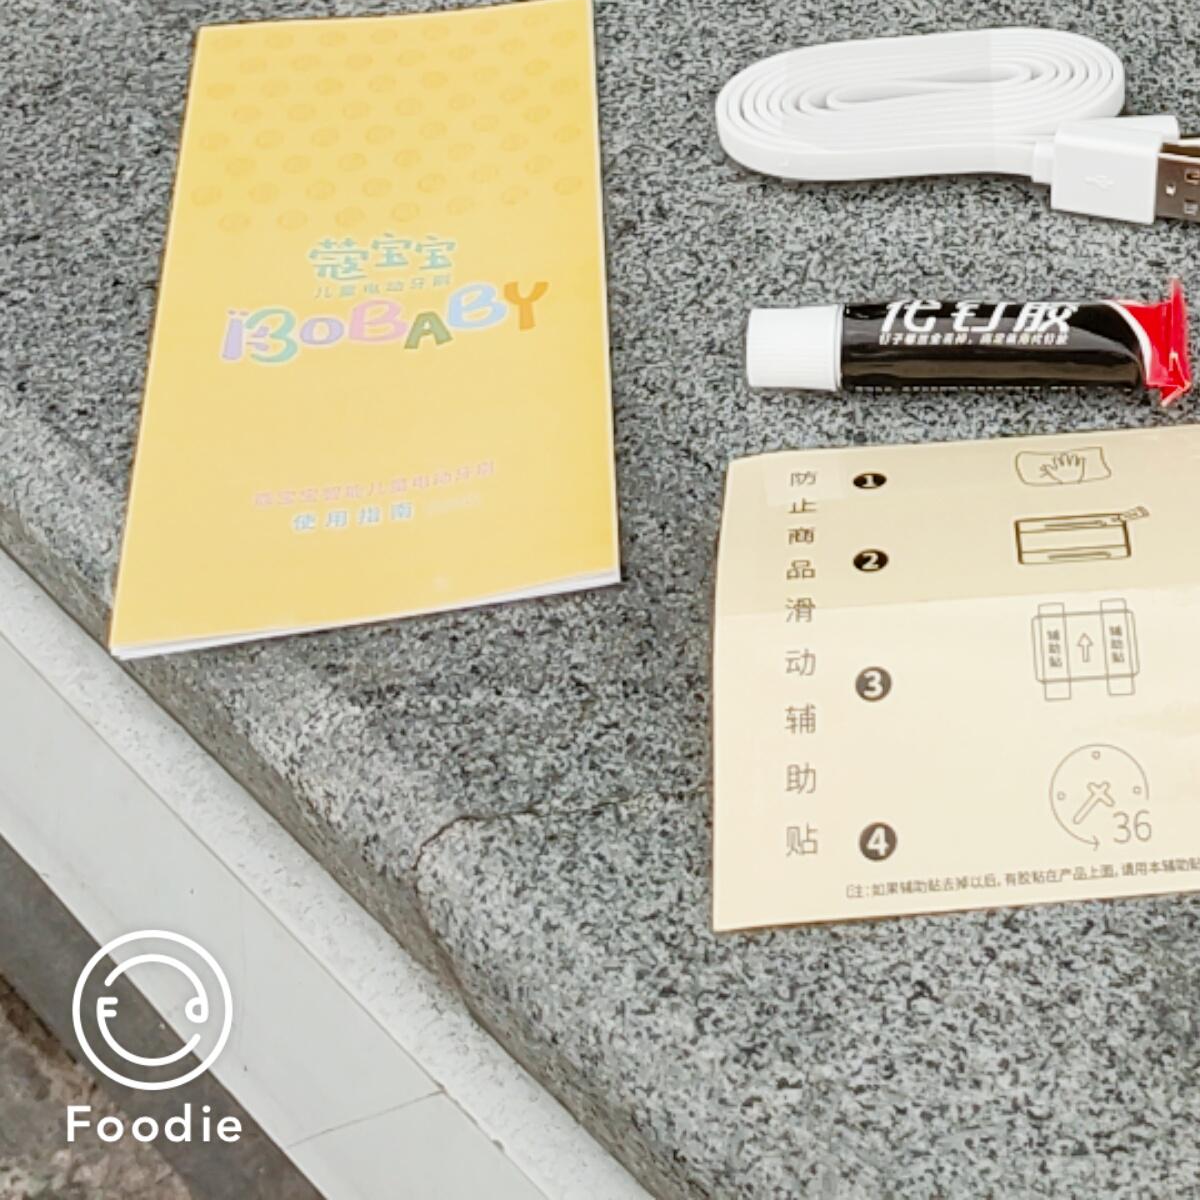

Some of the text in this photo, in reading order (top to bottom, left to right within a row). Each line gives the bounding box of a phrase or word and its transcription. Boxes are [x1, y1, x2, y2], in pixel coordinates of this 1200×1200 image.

[293, 502, 413, 530] 使用指南
[1112, 809, 1152, 844] 36
